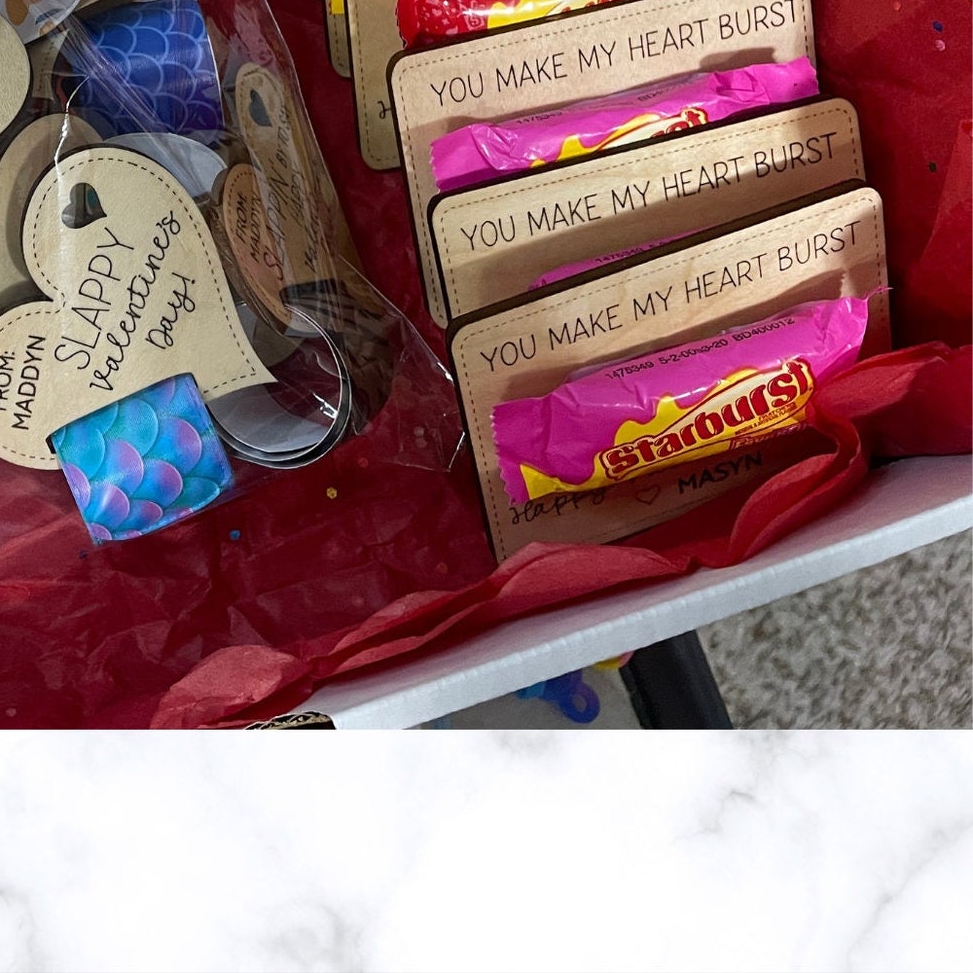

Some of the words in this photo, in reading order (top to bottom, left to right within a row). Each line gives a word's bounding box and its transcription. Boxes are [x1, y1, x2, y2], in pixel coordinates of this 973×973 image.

[431, 72, 485, 107] YOU
[496, 52, 568, 91] MAKE
[578, 42, 618, 73] MY
[628, 18, 710, 60] HEART
[461, 216, 517, 252] YOU
[527, 193, 601, 236] MAKE
[611, 180, 651, 215] MY
[663, 156, 745, 198] HEART
[755, 133, 838, 177] BURST
[53, 226, 135, 370] SLAPPY
[89, 209, 181, 391] Valentine's
[145, 272, 197, 350] Day!
[480, 335, 536, 372] YOU
[549, 307, 622, 350] MAKE
[632, 286, 673, 322] MY
[683, 253, 768, 304] HEART
[777, 221, 861, 272] BURST
[11, 334, 46, 430] MADDYN
[678, 449, 764, 495] MASYN
